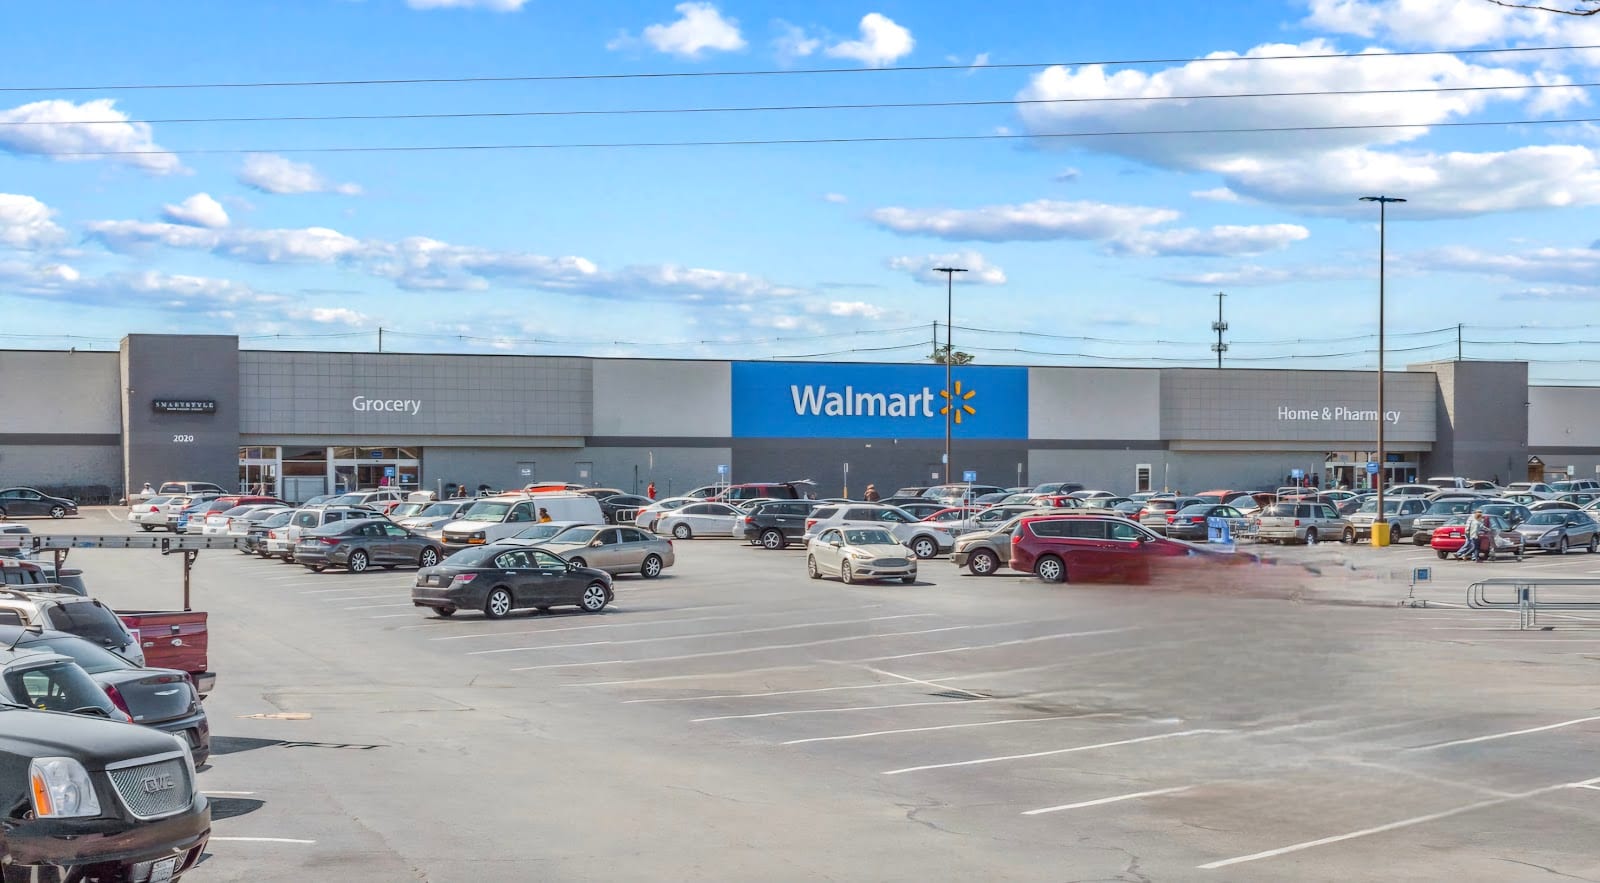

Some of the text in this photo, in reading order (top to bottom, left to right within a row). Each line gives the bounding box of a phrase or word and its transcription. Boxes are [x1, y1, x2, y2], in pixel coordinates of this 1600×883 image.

[352, 395, 421, 416] Grocery
[790, 384, 934, 418] Walmart
[1278, 406, 1319, 421] Home
[1321, 406, 1332, 421] &
[173, 434, 194, 442] 2020
